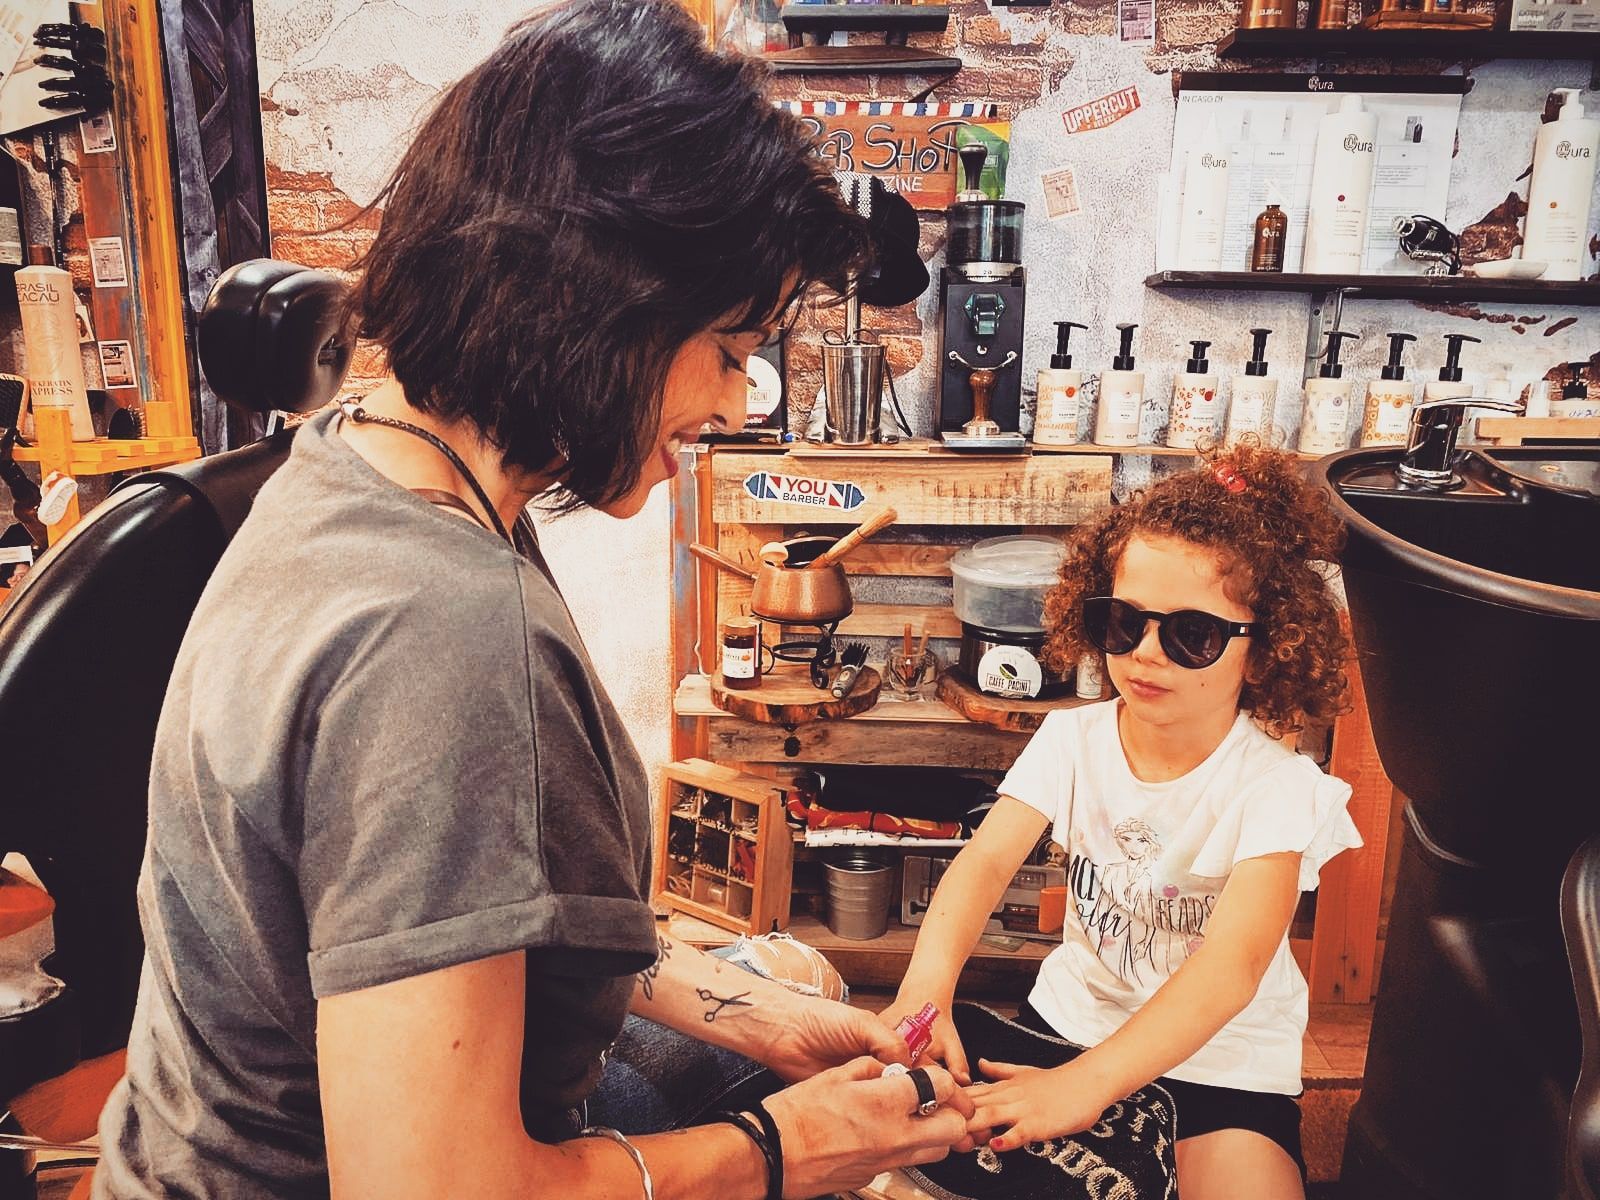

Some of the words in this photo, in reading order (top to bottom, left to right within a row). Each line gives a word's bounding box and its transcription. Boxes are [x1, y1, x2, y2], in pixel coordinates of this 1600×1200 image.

[1063, 88, 1138, 133] UPPERCUT
[785, 478, 828, 496] YOU
[782, 492, 826, 506] BARBER
